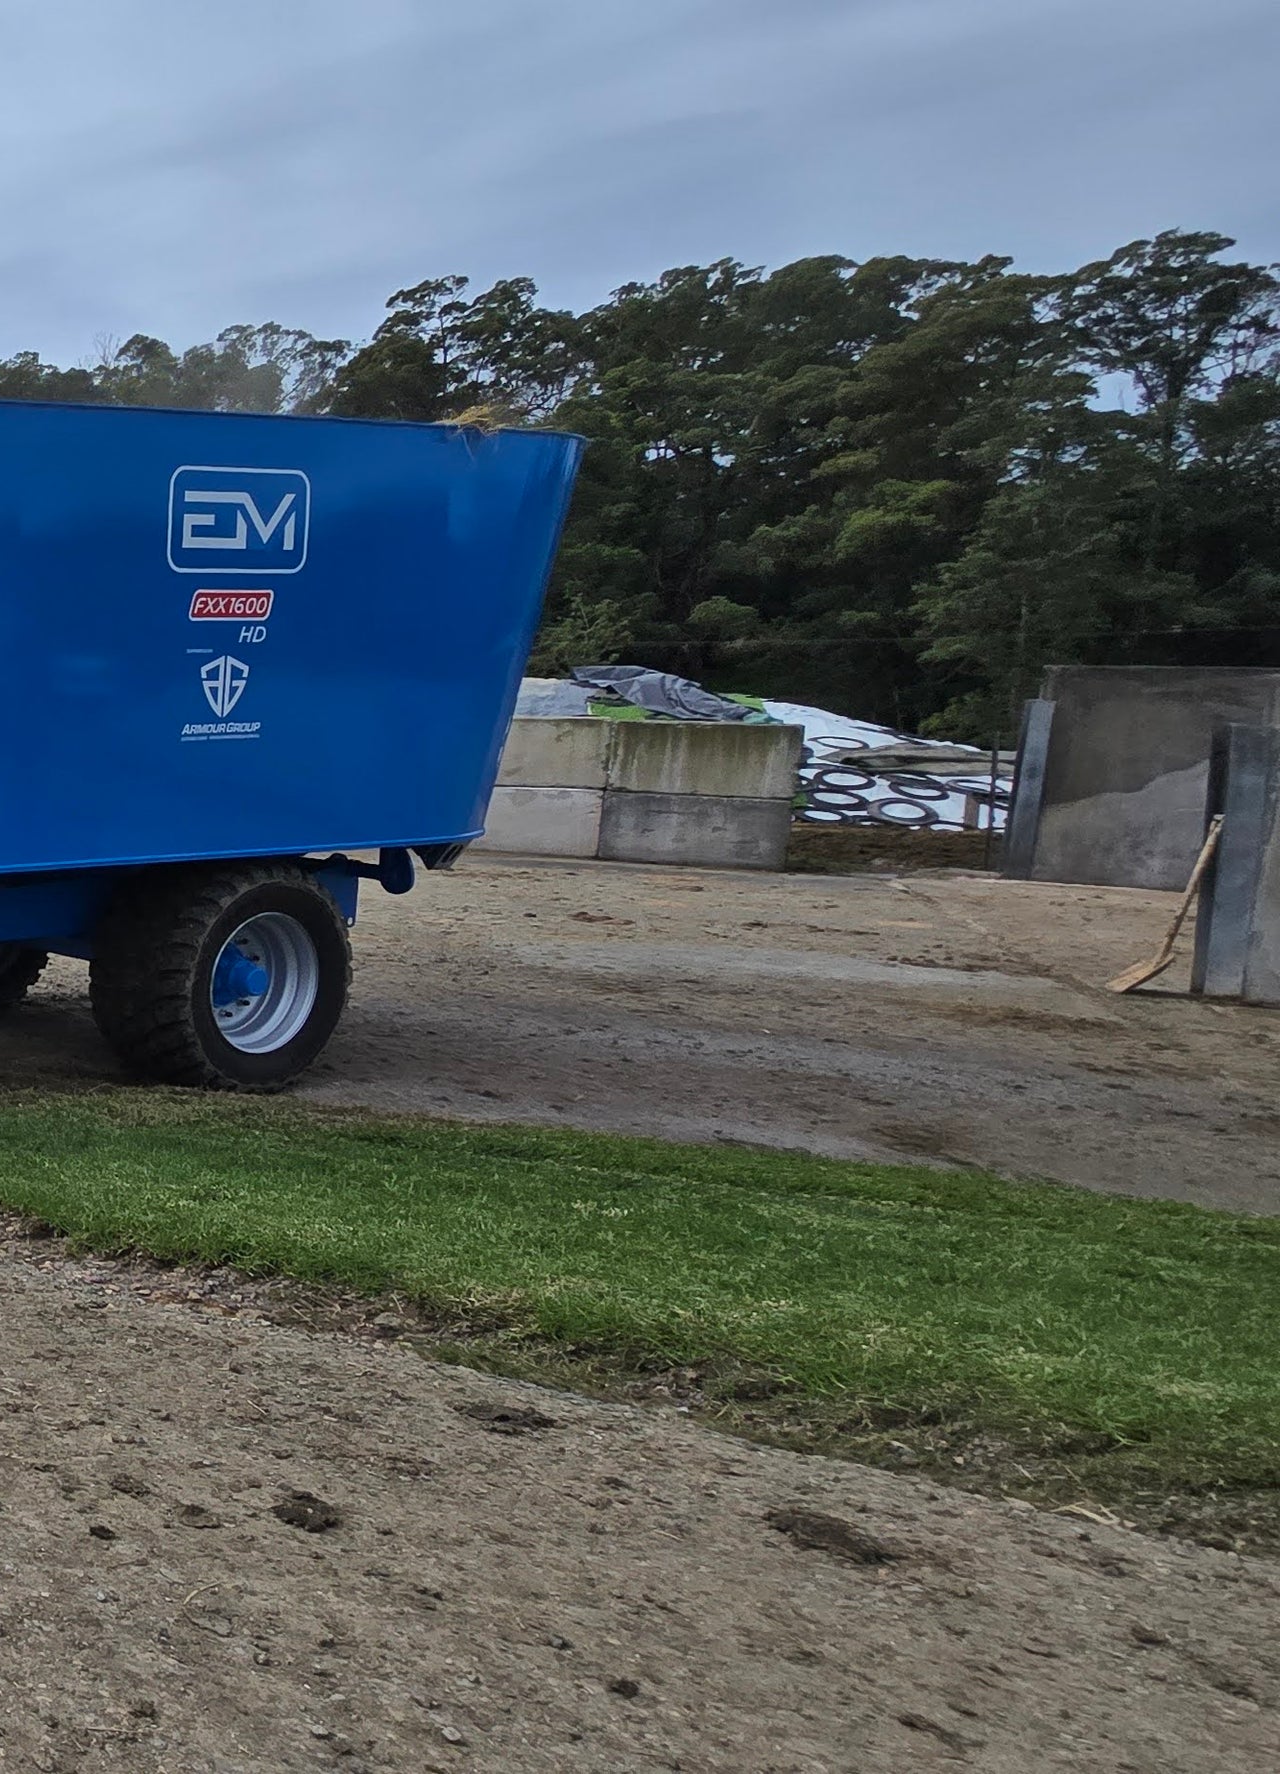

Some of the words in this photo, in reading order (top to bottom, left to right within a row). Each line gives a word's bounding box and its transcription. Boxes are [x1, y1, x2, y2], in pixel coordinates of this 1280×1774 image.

[182, 490, 296, 551] EM
[193, 596, 269, 614] FXX1600
[238, 625, 267, 643] HD
[181, 723, 227, 735] ARMOUR
[226, 722, 261, 733] GROUP
